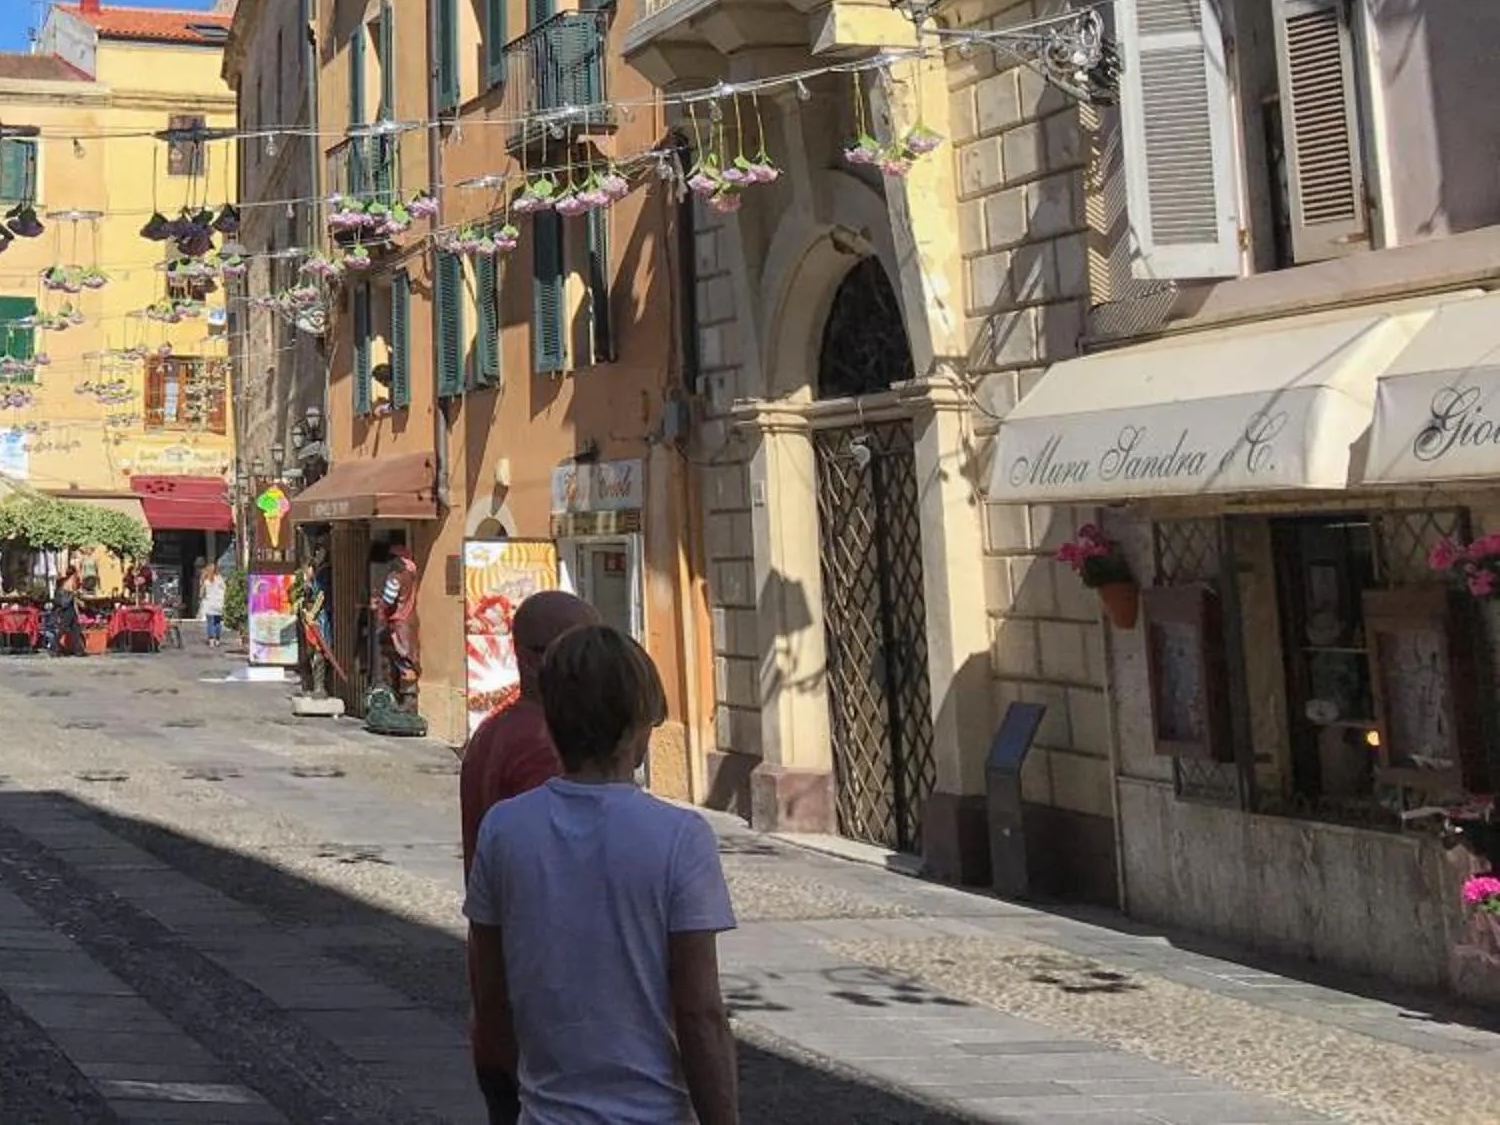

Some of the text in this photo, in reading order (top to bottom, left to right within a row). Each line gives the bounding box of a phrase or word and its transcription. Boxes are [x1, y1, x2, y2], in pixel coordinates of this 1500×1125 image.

[1009, 432, 1090, 488] Mura
[1100, 425, 1206, 482] Sandra
[1218, 448, 1236, 472] e
